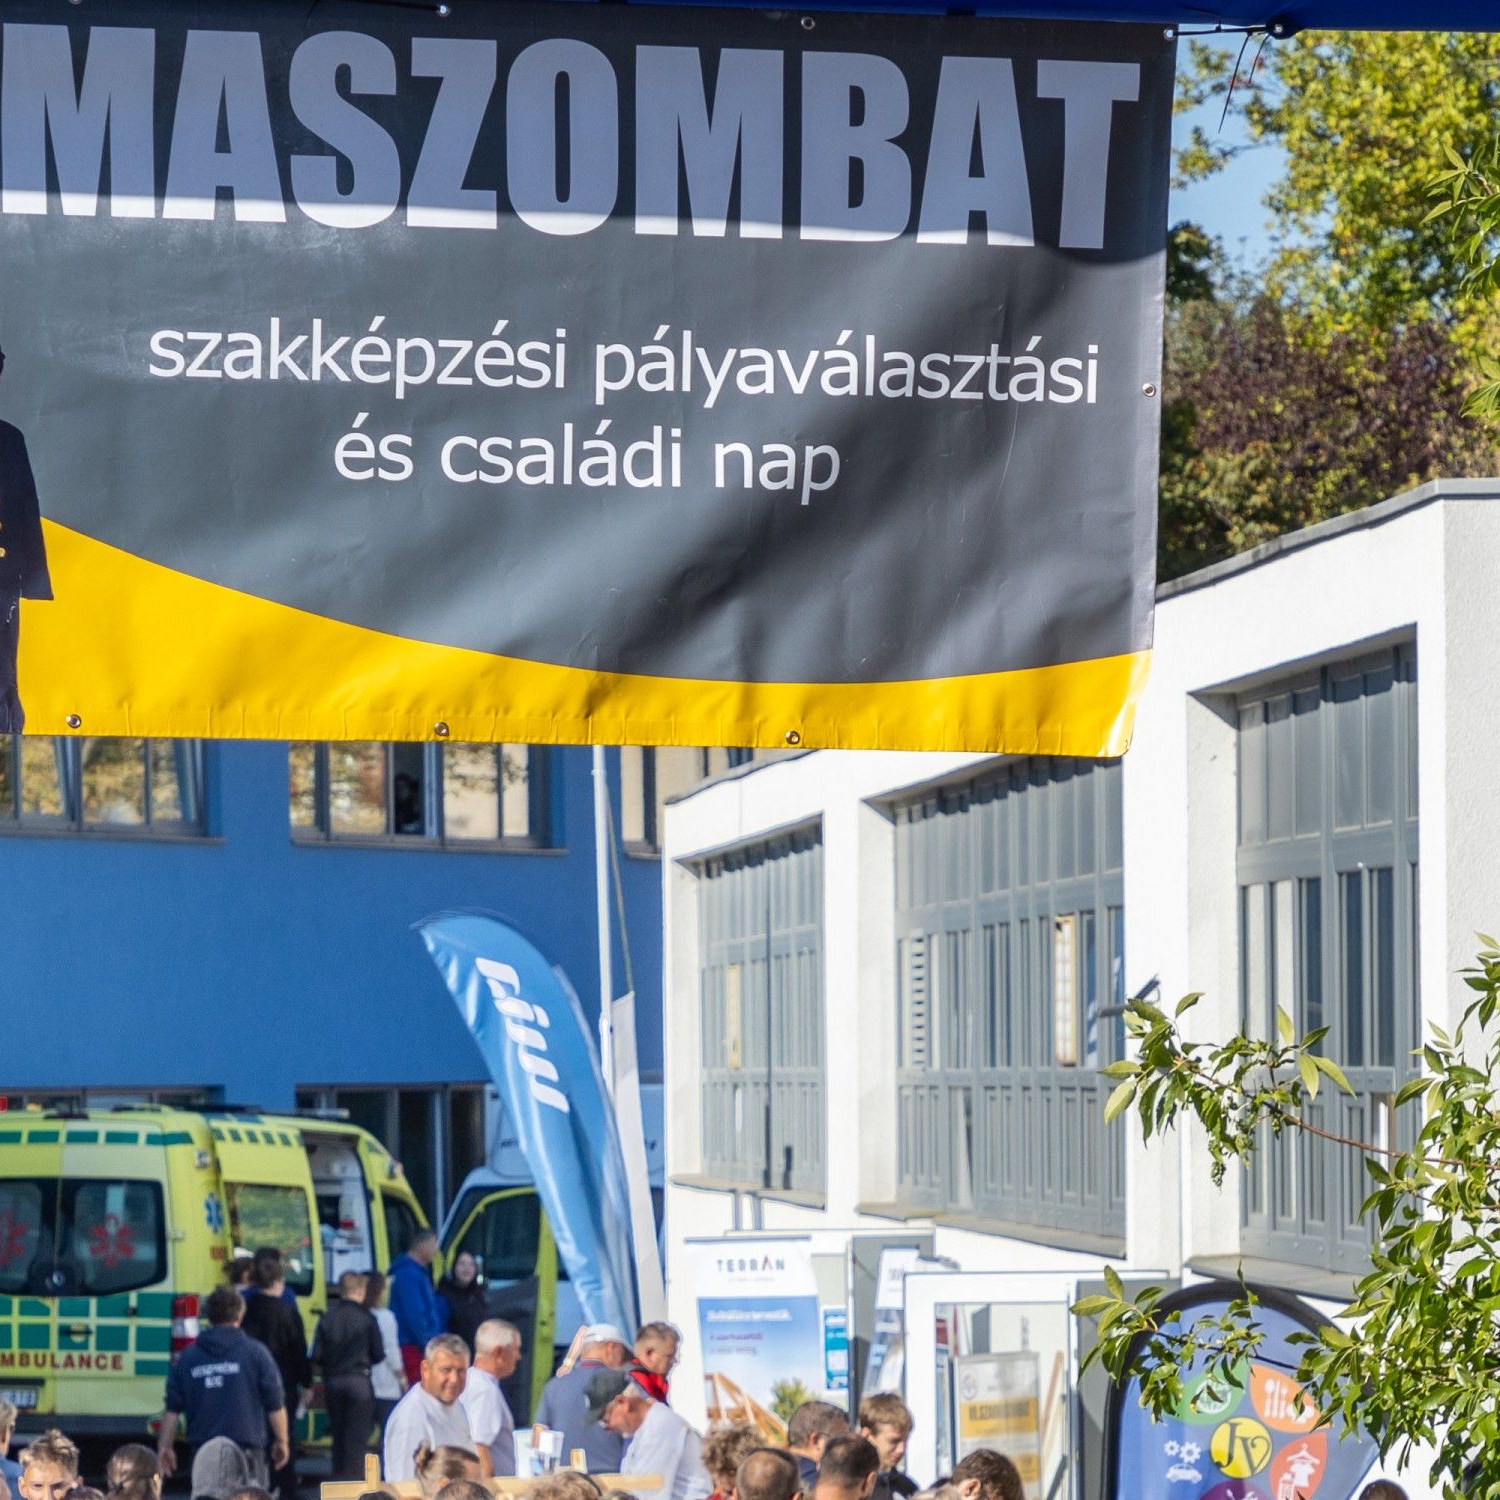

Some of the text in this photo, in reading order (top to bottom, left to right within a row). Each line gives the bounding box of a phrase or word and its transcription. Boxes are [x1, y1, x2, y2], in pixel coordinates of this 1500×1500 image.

[149, 315, 1099, 409] szakképzési pályaválasztási
[334, 412, 841, 505] és családi nap
